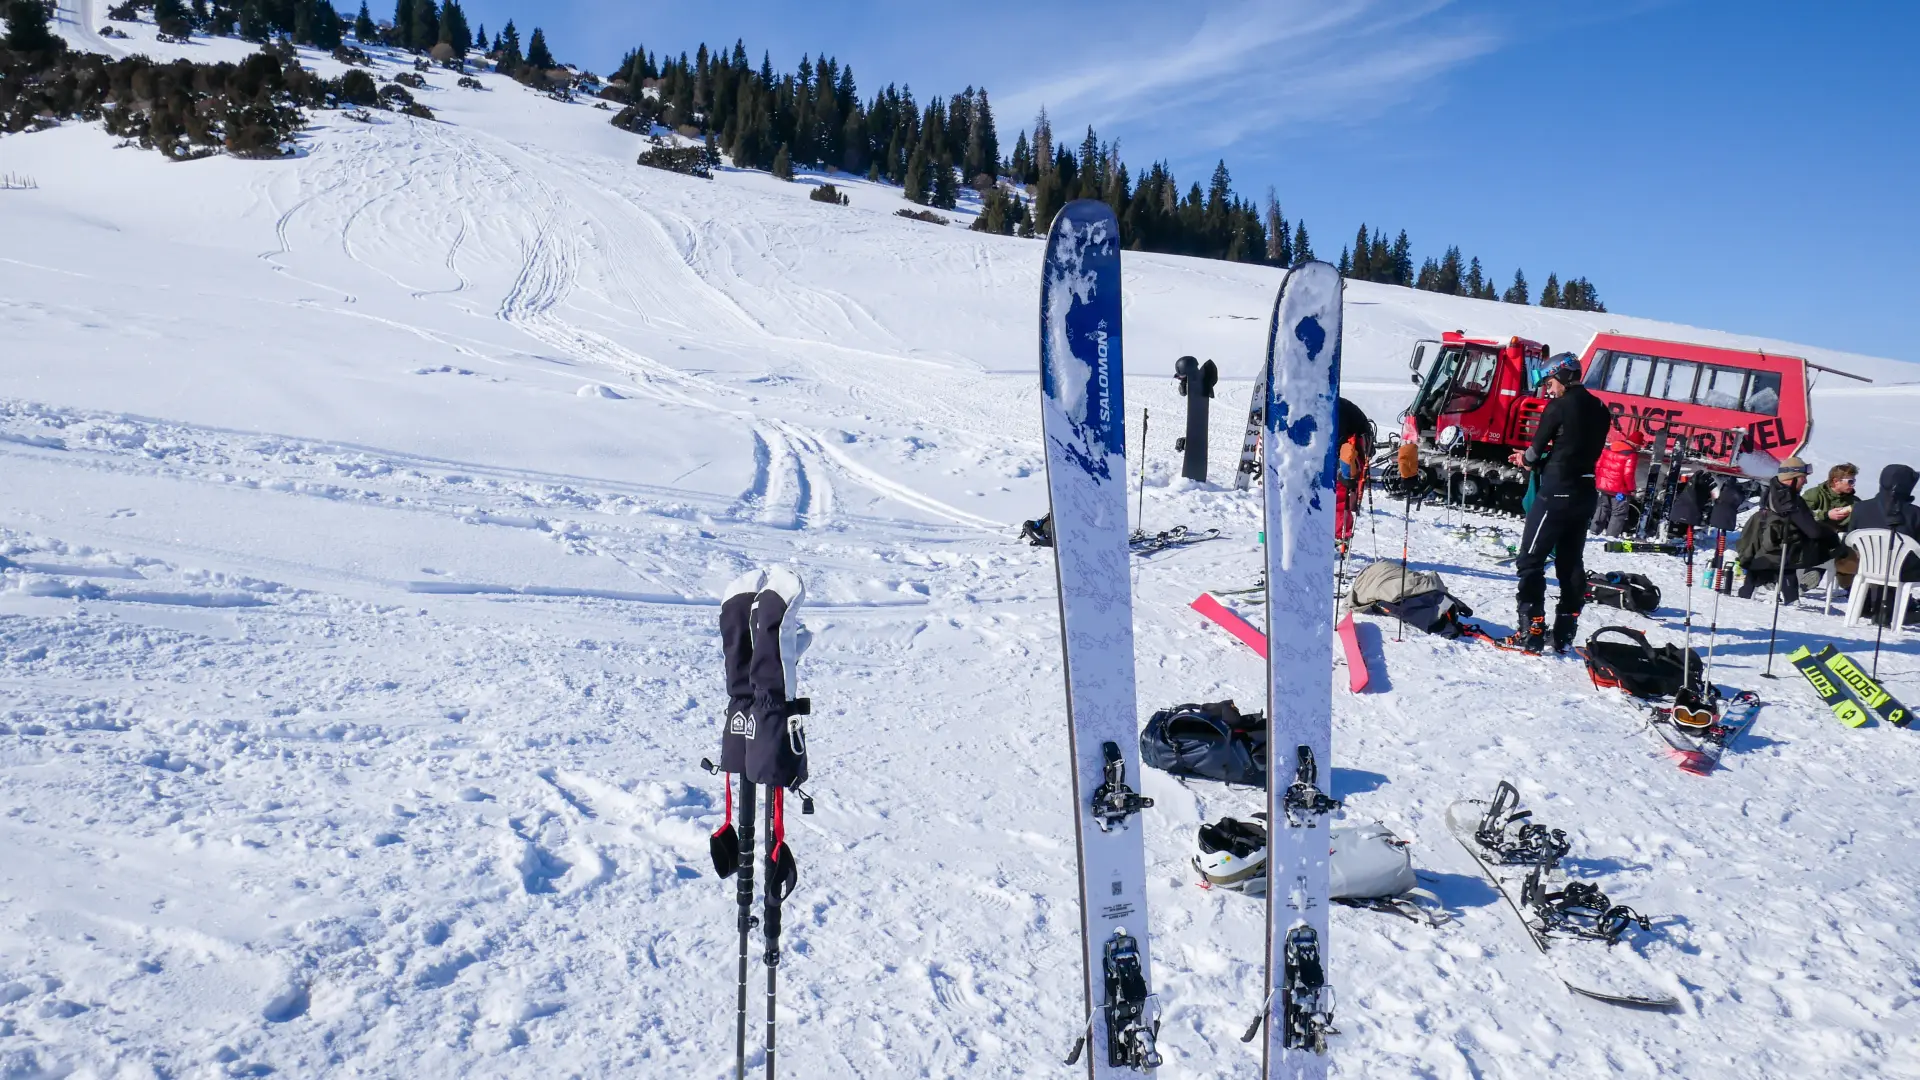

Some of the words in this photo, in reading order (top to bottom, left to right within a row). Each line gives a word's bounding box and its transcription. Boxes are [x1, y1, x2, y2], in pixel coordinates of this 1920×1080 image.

[1098, 330, 1110, 422] SALOMON
[1690, 417, 1797, 459] RAVEL
[1801, 665, 1838, 698] SCOTT
[1835, 664, 1877, 698] SCOTT
